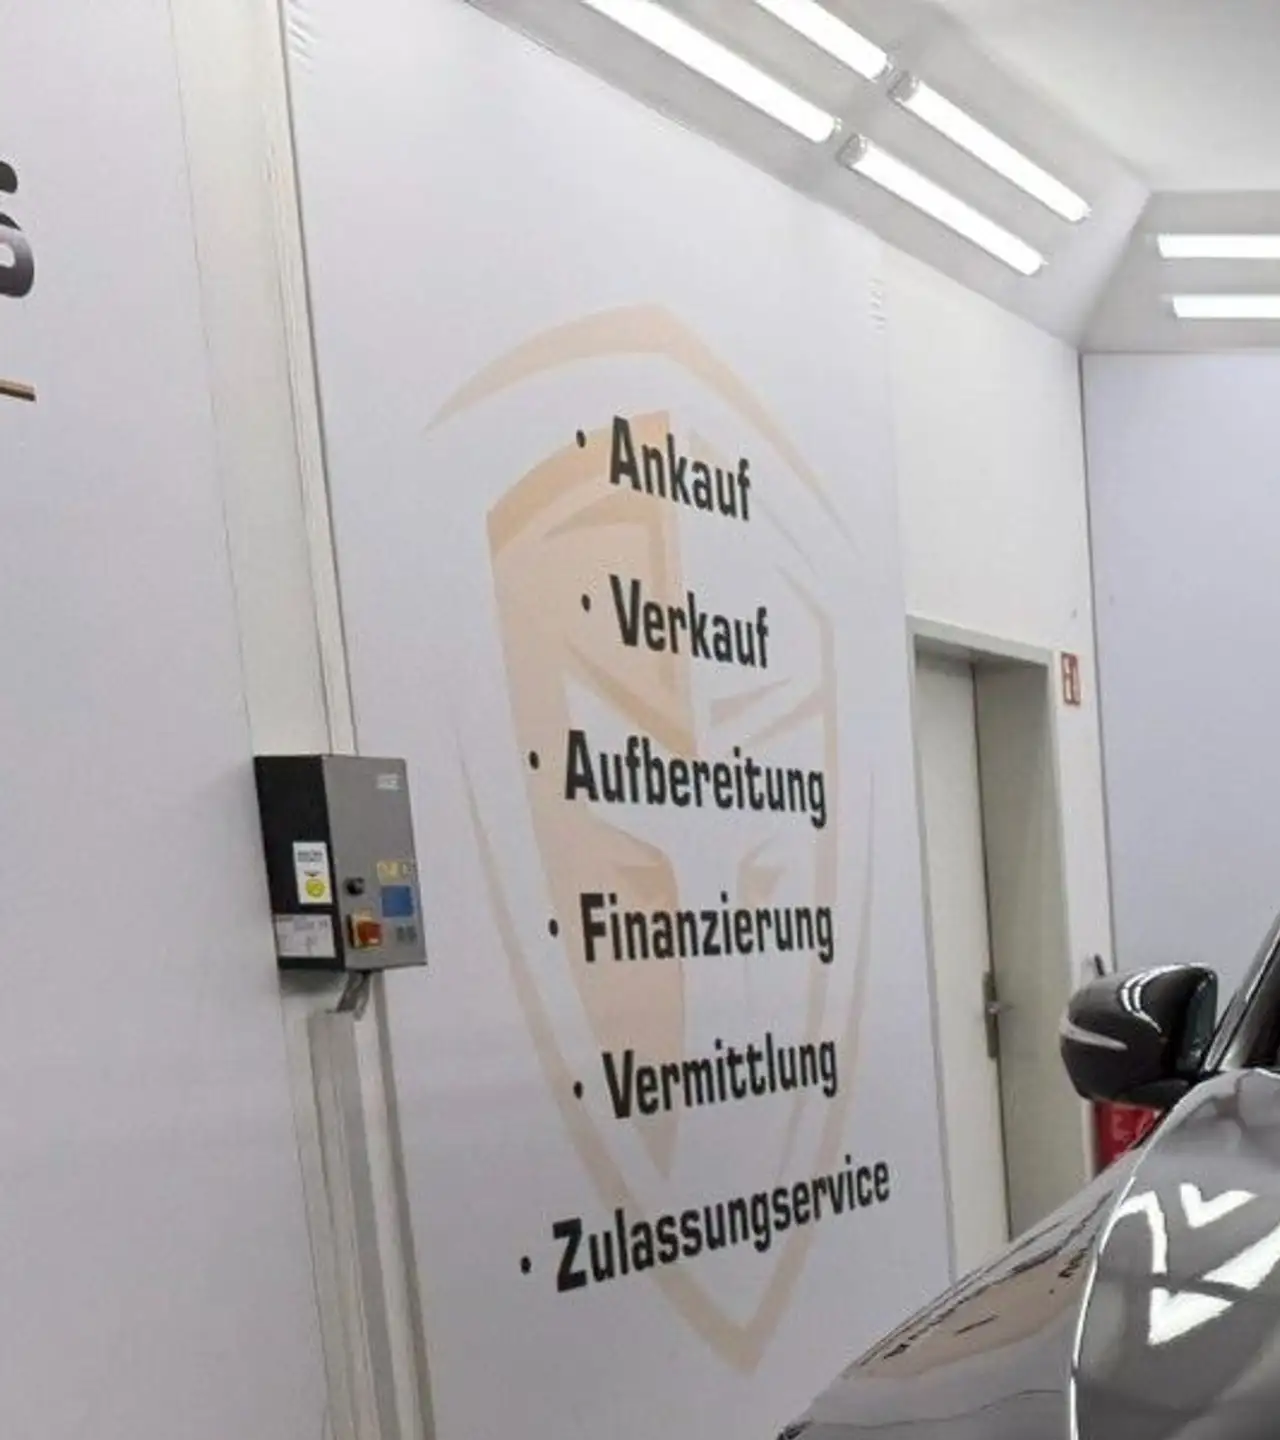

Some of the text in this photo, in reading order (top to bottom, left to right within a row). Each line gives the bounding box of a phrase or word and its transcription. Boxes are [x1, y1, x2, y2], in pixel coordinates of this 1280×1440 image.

[609, 415, 751, 522] Ankauf
[608, 573, 769, 670] Verkauf
[563, 728, 829, 830] Aufbereitung
[579, 891, 835, 965] Finanzierung
[600, 1031, 839, 1121] Vermittlung
[550, 1153, 891, 1295] Zulassungservice
